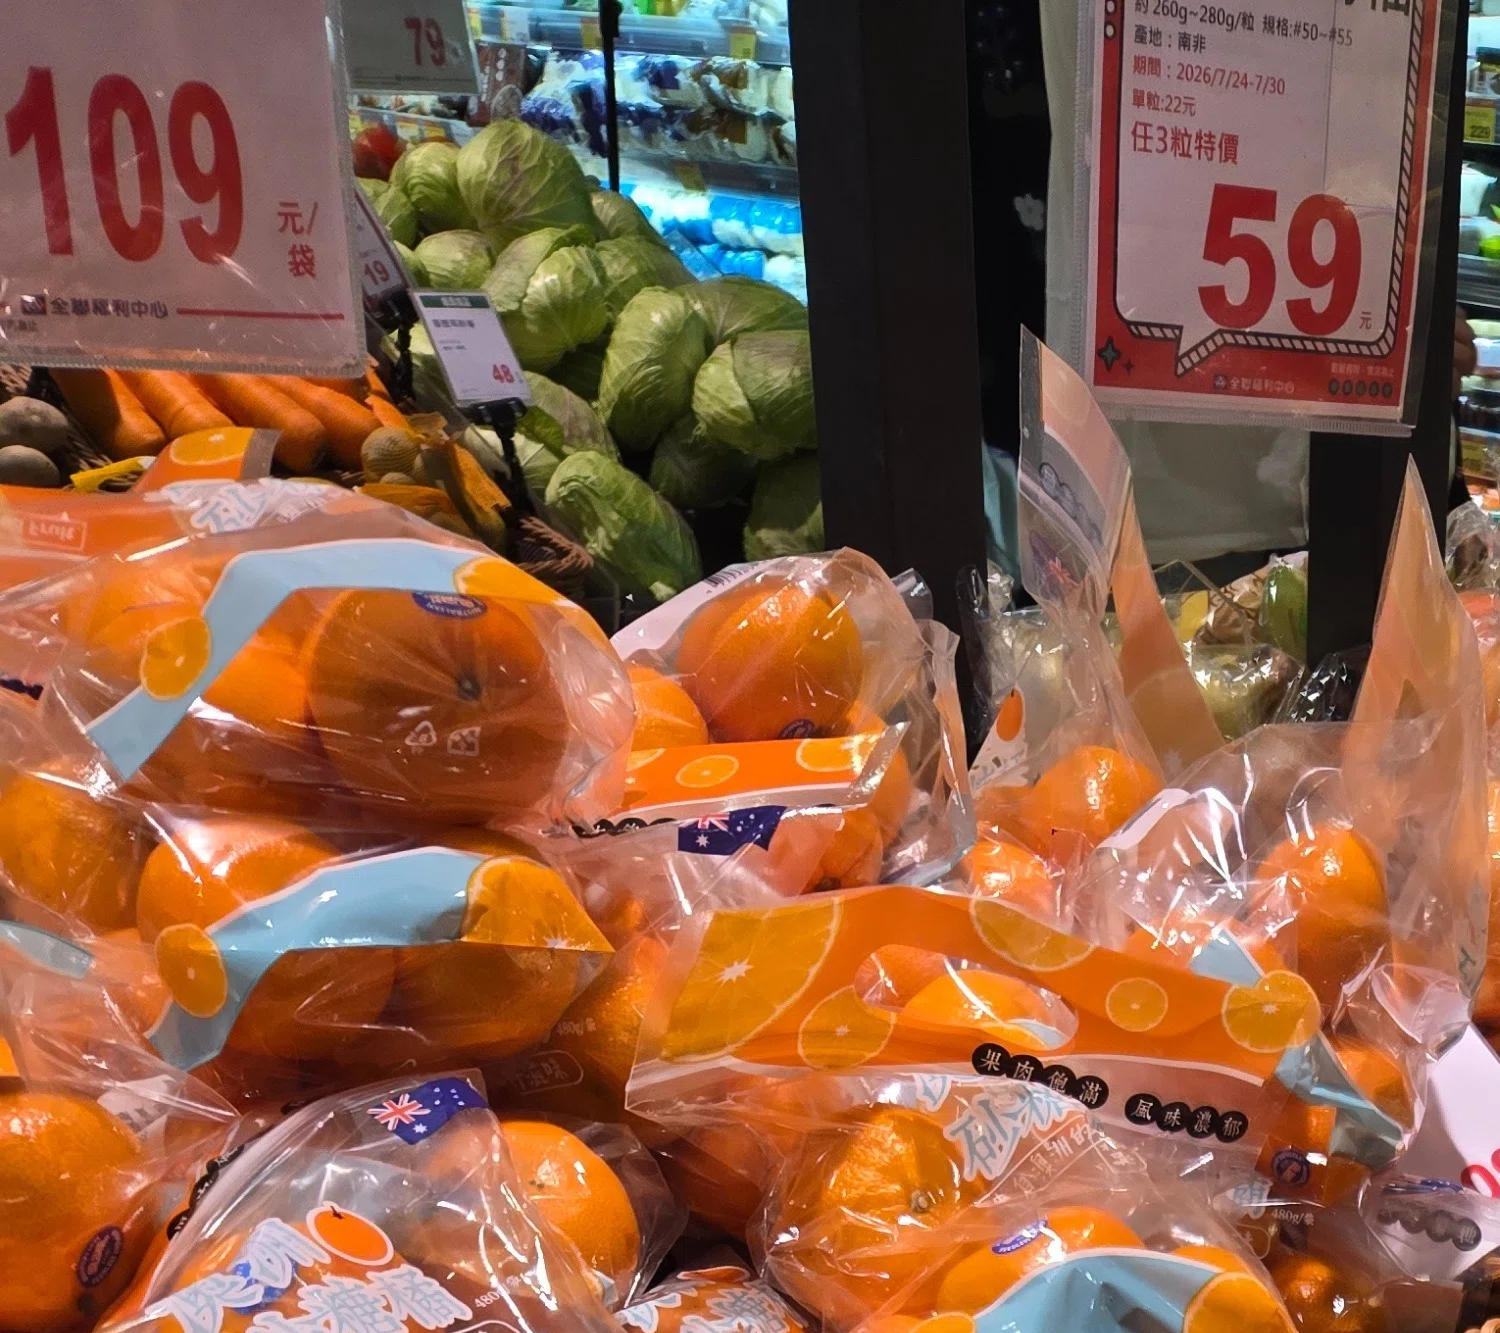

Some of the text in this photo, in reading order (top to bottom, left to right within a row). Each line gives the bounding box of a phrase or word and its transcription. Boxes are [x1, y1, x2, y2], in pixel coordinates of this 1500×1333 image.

[404, 16, 447, 66] 79
[5, 66, 244, 265] 109
[1131, 120, 1240, 166] 任3粒特價
[363, 259, 390, 286] 19
[1196, 182, 1362, 337] 59
[1358, 311, 1373, 331] 元
[980, 1047, 1102, 1105] 果肉飽滿
[1131, 1098, 1244, 1136] 風味濃郁
